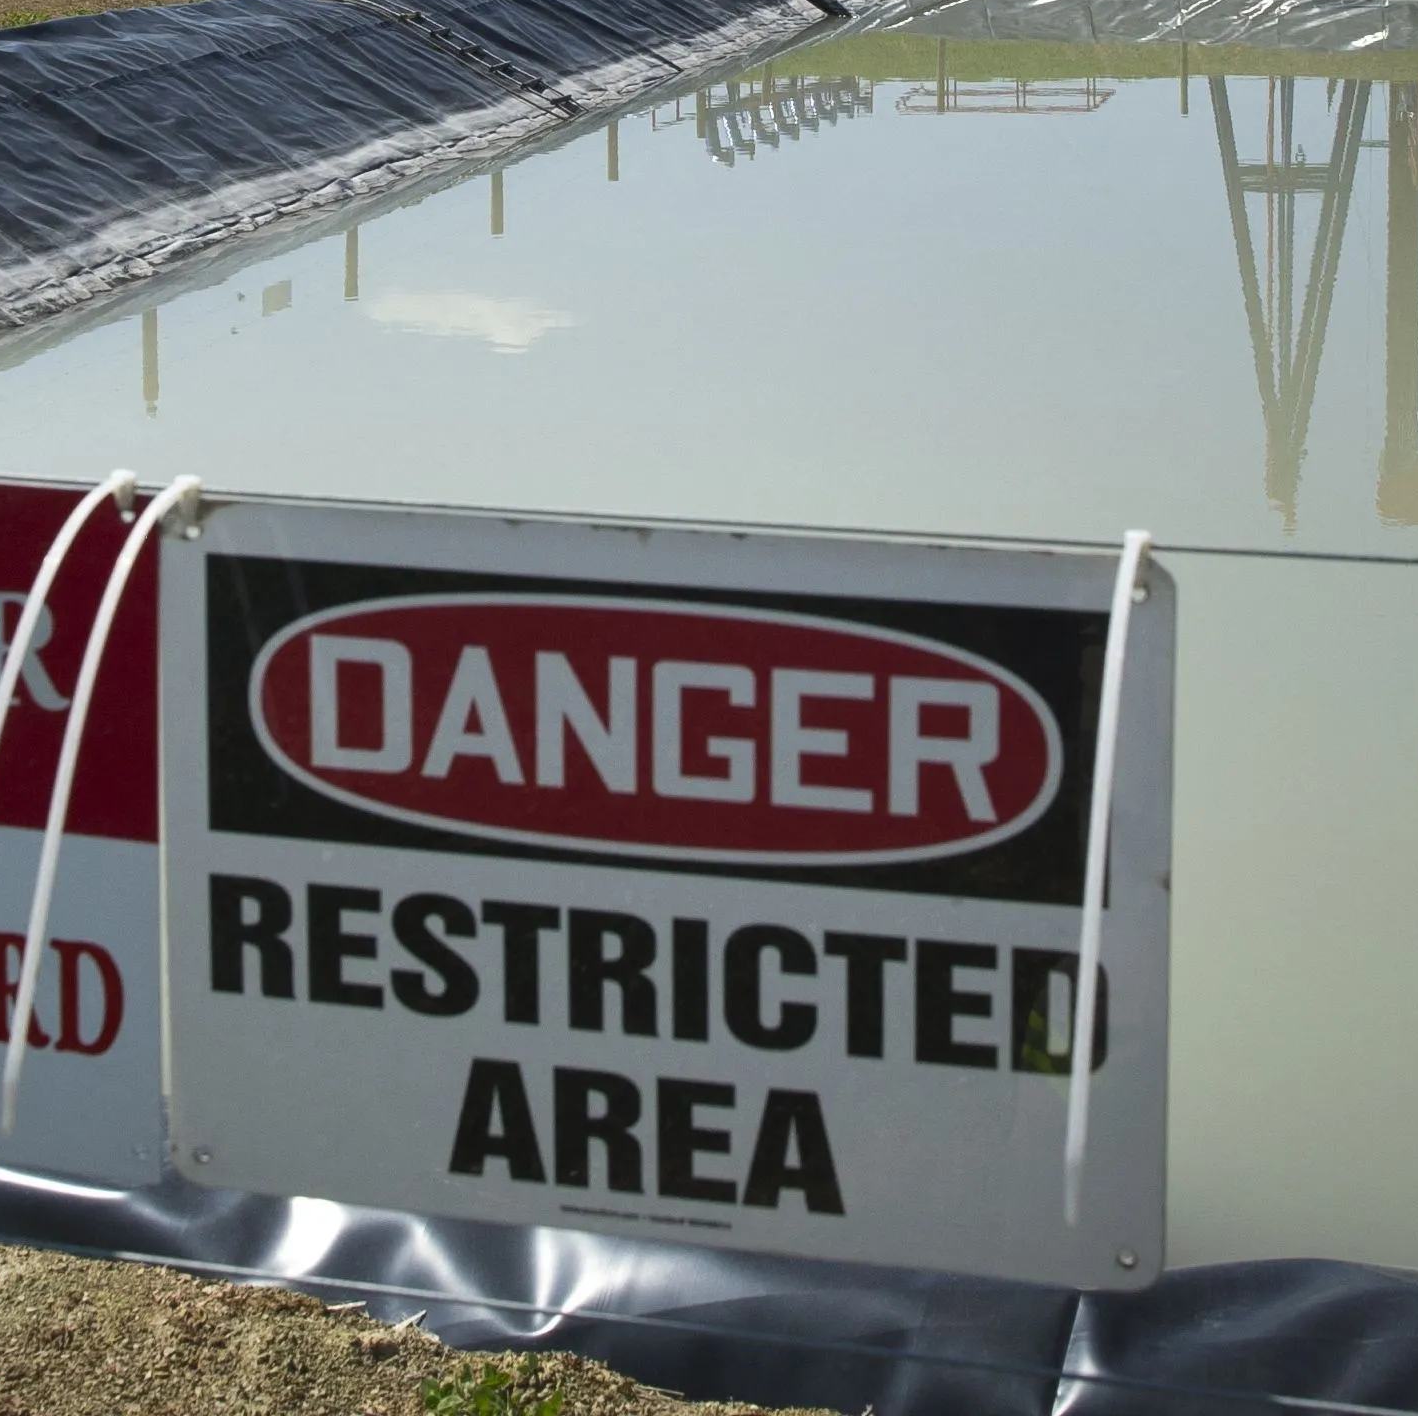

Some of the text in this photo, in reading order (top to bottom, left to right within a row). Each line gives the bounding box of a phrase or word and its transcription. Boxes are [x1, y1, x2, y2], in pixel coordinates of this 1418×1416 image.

[308, 633, 1000, 824] DANGER
[208, 872, 1110, 1076] RESTRICTED
[448, 1056, 846, 1216] AREA
